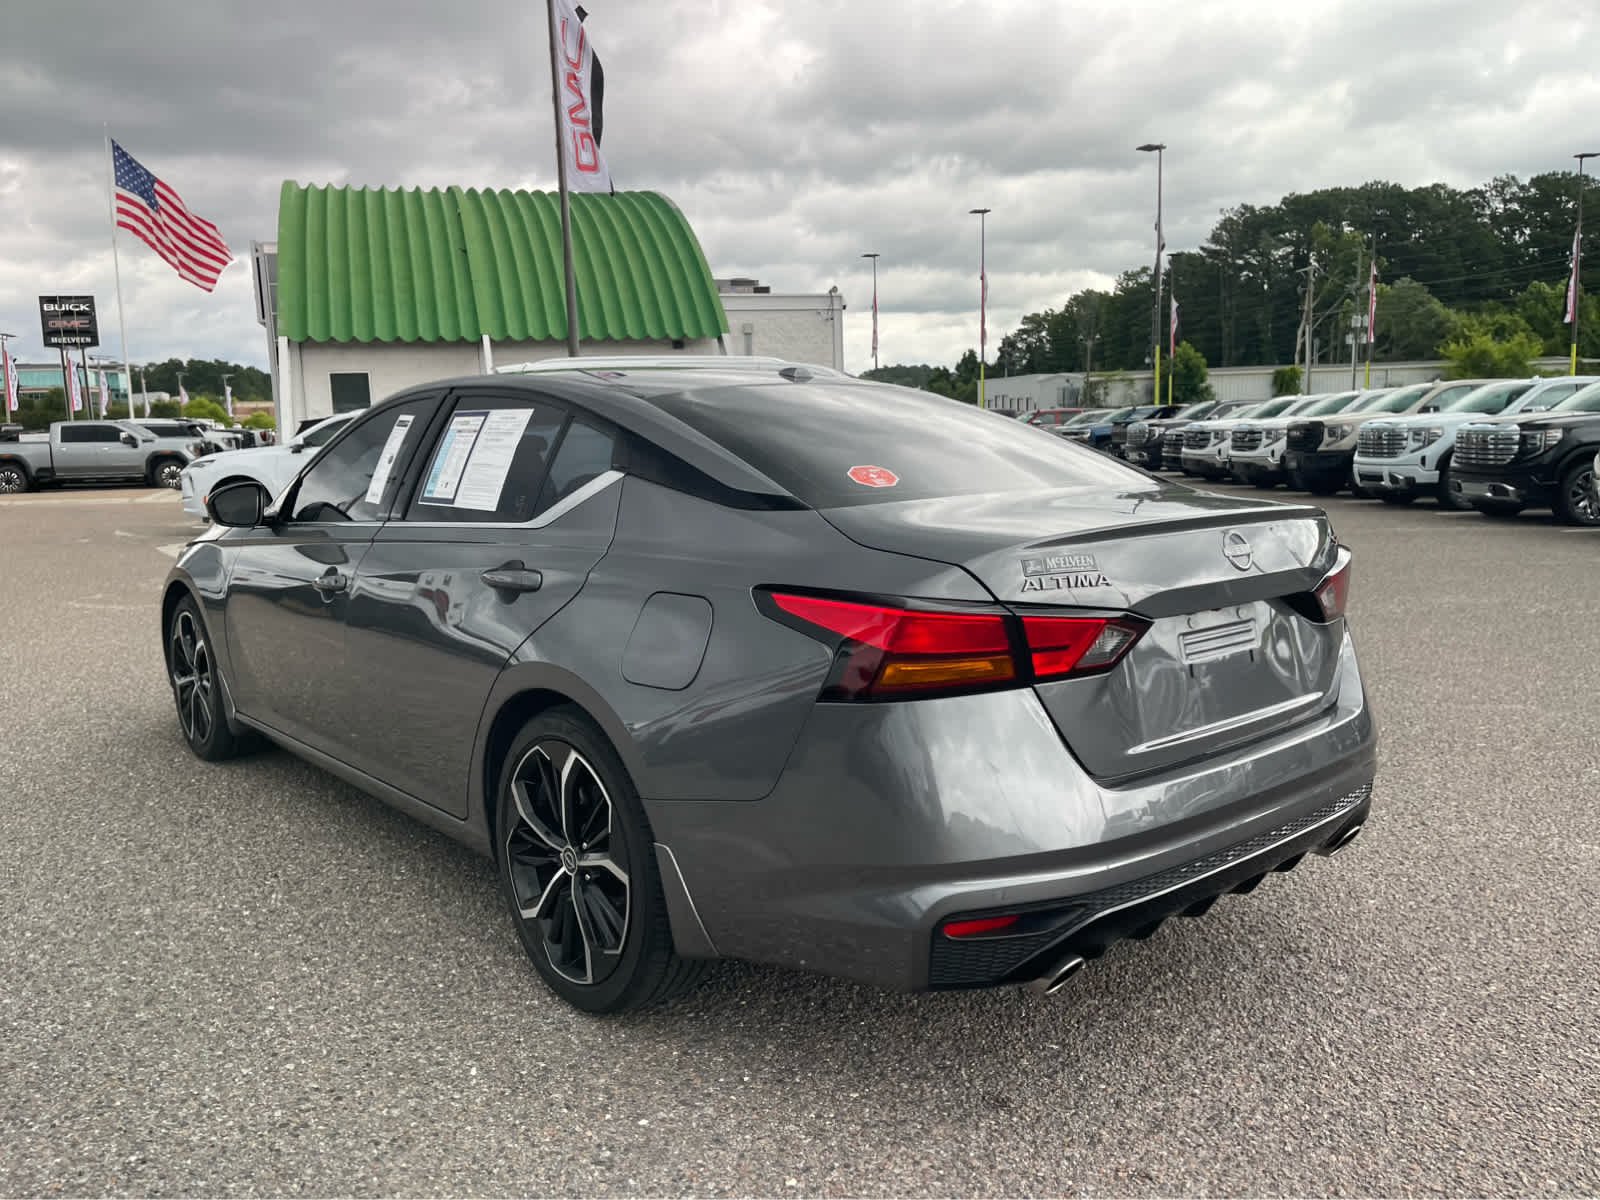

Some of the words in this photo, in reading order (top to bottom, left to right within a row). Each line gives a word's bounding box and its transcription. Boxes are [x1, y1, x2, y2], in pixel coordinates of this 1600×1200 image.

[560, 17, 600, 174] GMC
[43, 303, 91, 311] BUICK
[1021, 574, 1112, 592] ALTIMA
